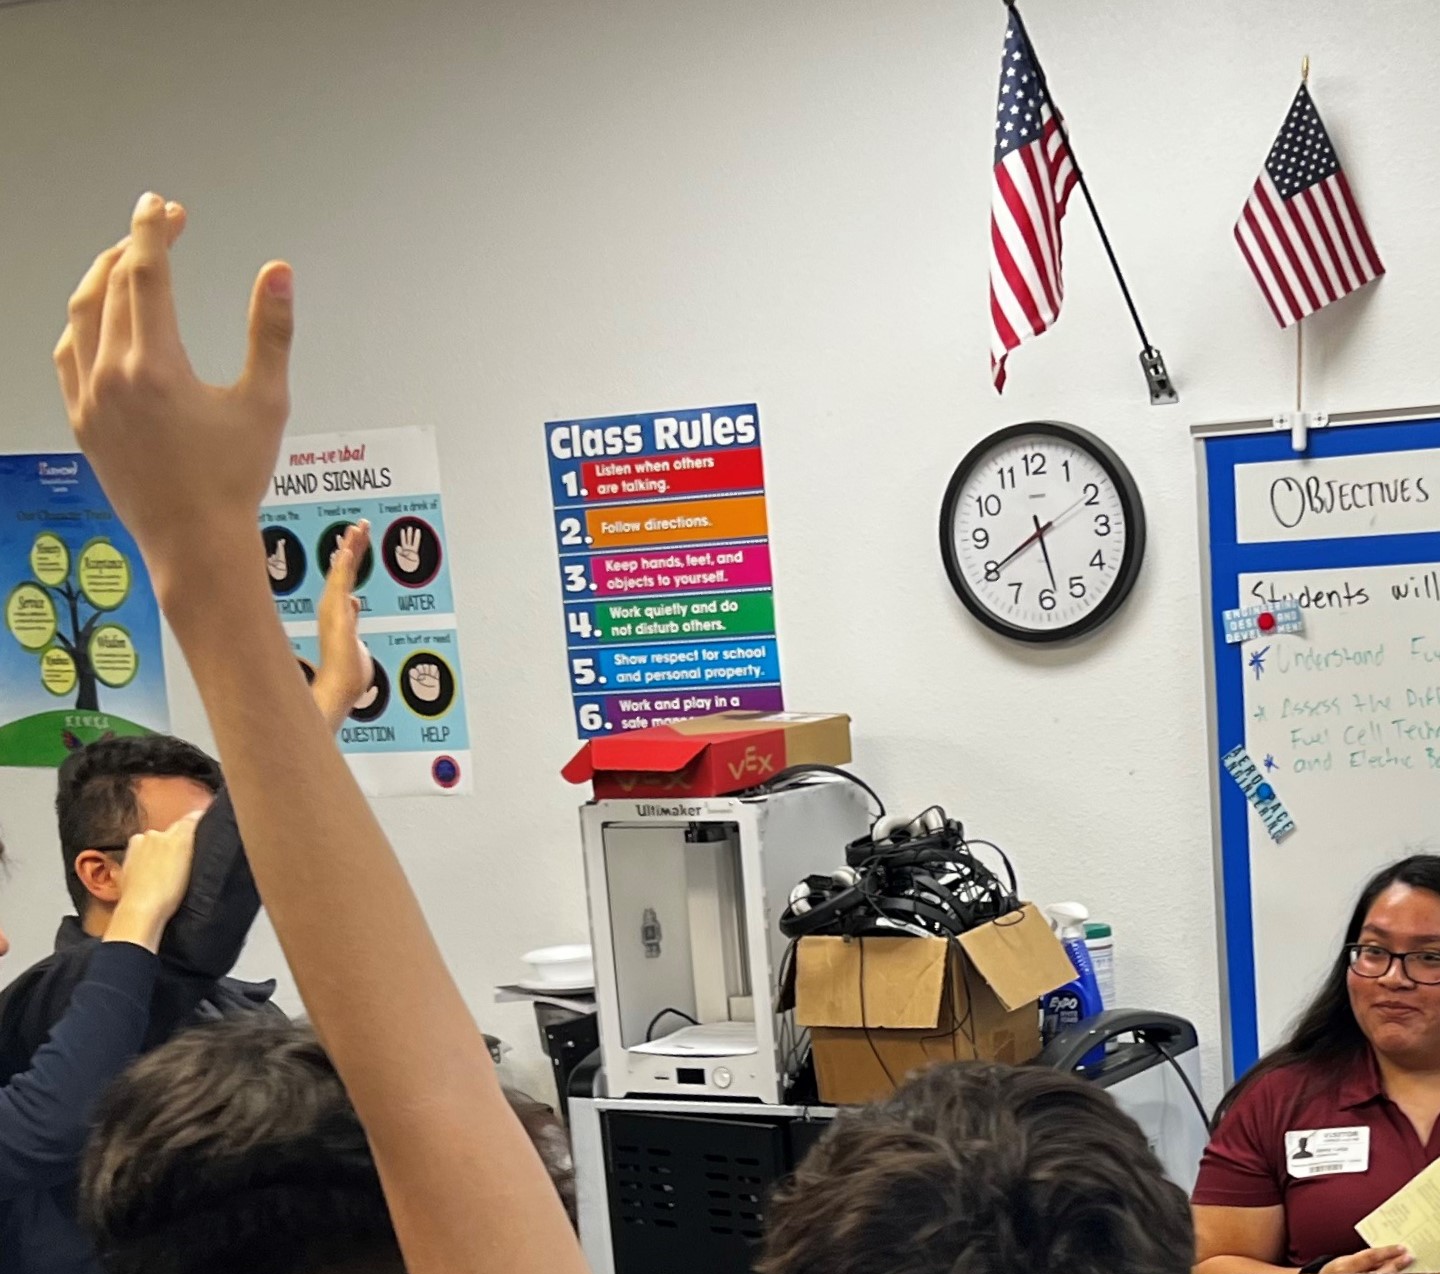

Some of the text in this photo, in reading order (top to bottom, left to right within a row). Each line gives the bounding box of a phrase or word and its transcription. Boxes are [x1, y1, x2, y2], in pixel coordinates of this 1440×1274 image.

[550, 413, 755, 459] Class Rules
[289, 444, 366, 466] non-verbal
[1022, 453, 1047, 476] 12
[595, 456, 715, 477] Listen when others
[998, 466, 1016, 489] 11
[1062, 460, 1071, 482] 1
[273, 467, 392, 496] HAND SIGNALS
[561, 471, 588, 497] 1.
[597, 479, 670, 495] are talking.
[1083, 483, 1100, 506] 2
[1270, 476, 1430, 528] OBJECTIVES
[976, 494, 1001, 518] 10
[559, 517, 594, 545] 2.
[601, 516, 713, 534] Follow directions.
[1094, 514, 1111, 536] 3
[972, 528, 989, 549] 9
[605, 551, 744, 573] Keep hands, feet, and
[984, 560, 1000, 582] 8
[1089, 549, 1106, 571] 4
[563, 564, 598, 592] 3.
[606, 570, 729, 591] objects to yourself.
[1069, 576, 1086, 598] 5
[1391, 571, 1440, 601] will
[398, 594, 436, 611] WATER
[1008, 582, 1023, 605] 7
[1039, 588, 1056, 610] 6
[609, 600, 739, 619] Work quietly and do
[1277, 610, 1298, 621] AND
[568, 612, 603, 638] 4.
[611, 618, 727, 637] not disturb others.
[613, 646, 766, 666] Show respect for school
[1276, 644, 1384, 674] Understand
[572, 658, 607, 685] 5.
[616, 664, 766, 684] and personal property.
[619, 695, 741, 712] Work and play in a
[1281, 697, 1342, 719] Assess
[1353, 694, 1391, 714] the
[579, 704, 613, 730] 6.
[620, 716, 648, 730] safe
[341, 726, 396, 743] QUESTION
[421, 726, 450, 743] HELP
[1290, 727, 1328, 750] Fuel
[1343, 720, 1382, 746] Cell
[729, 745, 773, 781] VEX
[1293, 751, 1333, 774] and
[1350, 748, 1413, 769] Electric
[637, 805, 702, 817] Ultimaker
